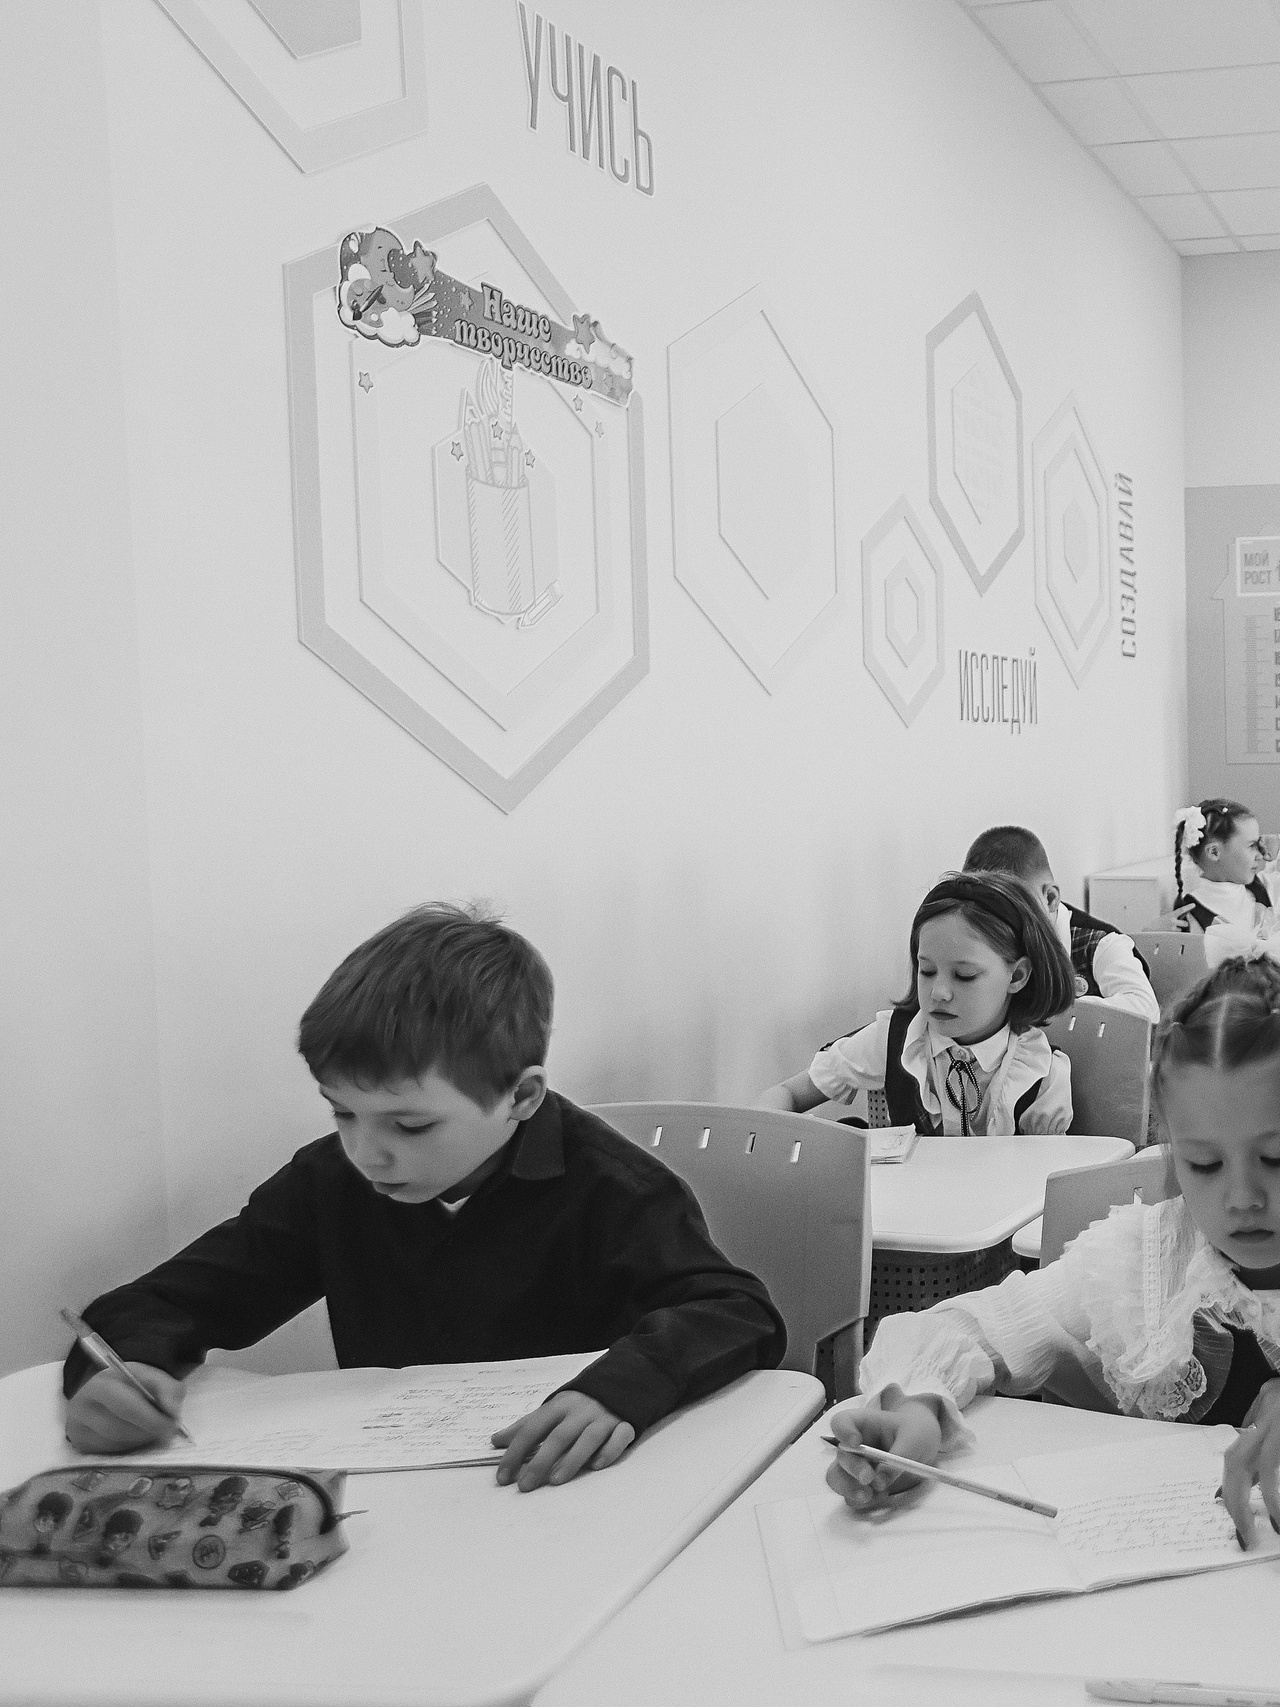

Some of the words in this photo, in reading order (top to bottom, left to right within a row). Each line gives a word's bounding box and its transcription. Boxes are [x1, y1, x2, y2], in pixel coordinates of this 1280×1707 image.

[517, 0, 655, 197] УЧИСЬ
[481, 282, 551, 343] Наше
[454, 318, 593, 389] творчество
[1114, 472, 1137, 659] СОЗДАВАЙ
[1243, 550, 1269, 567] МОЙ
[1244, 570, 1272, 585] РОСТ
[958, 646, 1038, 735] ИССЛЕДУЙ
